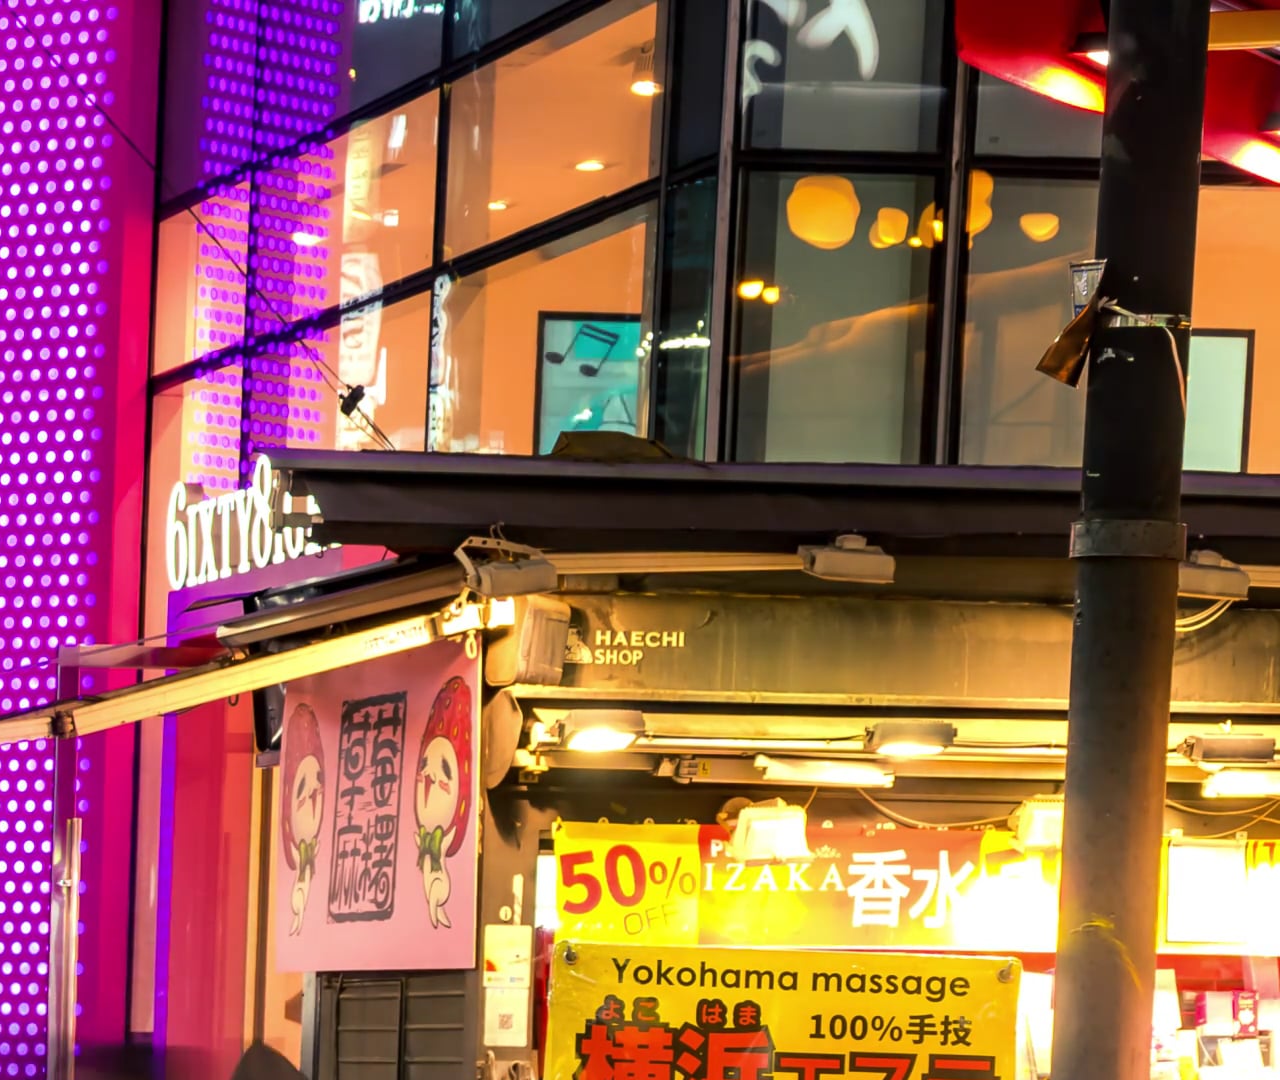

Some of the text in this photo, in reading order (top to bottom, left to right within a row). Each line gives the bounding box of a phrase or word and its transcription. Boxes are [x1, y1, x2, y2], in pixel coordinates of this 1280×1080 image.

[595, 629, 686, 648] HAECHI
[594, 649, 644, 666] SHOP
[560, 844, 696, 915] 50%
[611, 957, 971, 1003] Yokohama massage
